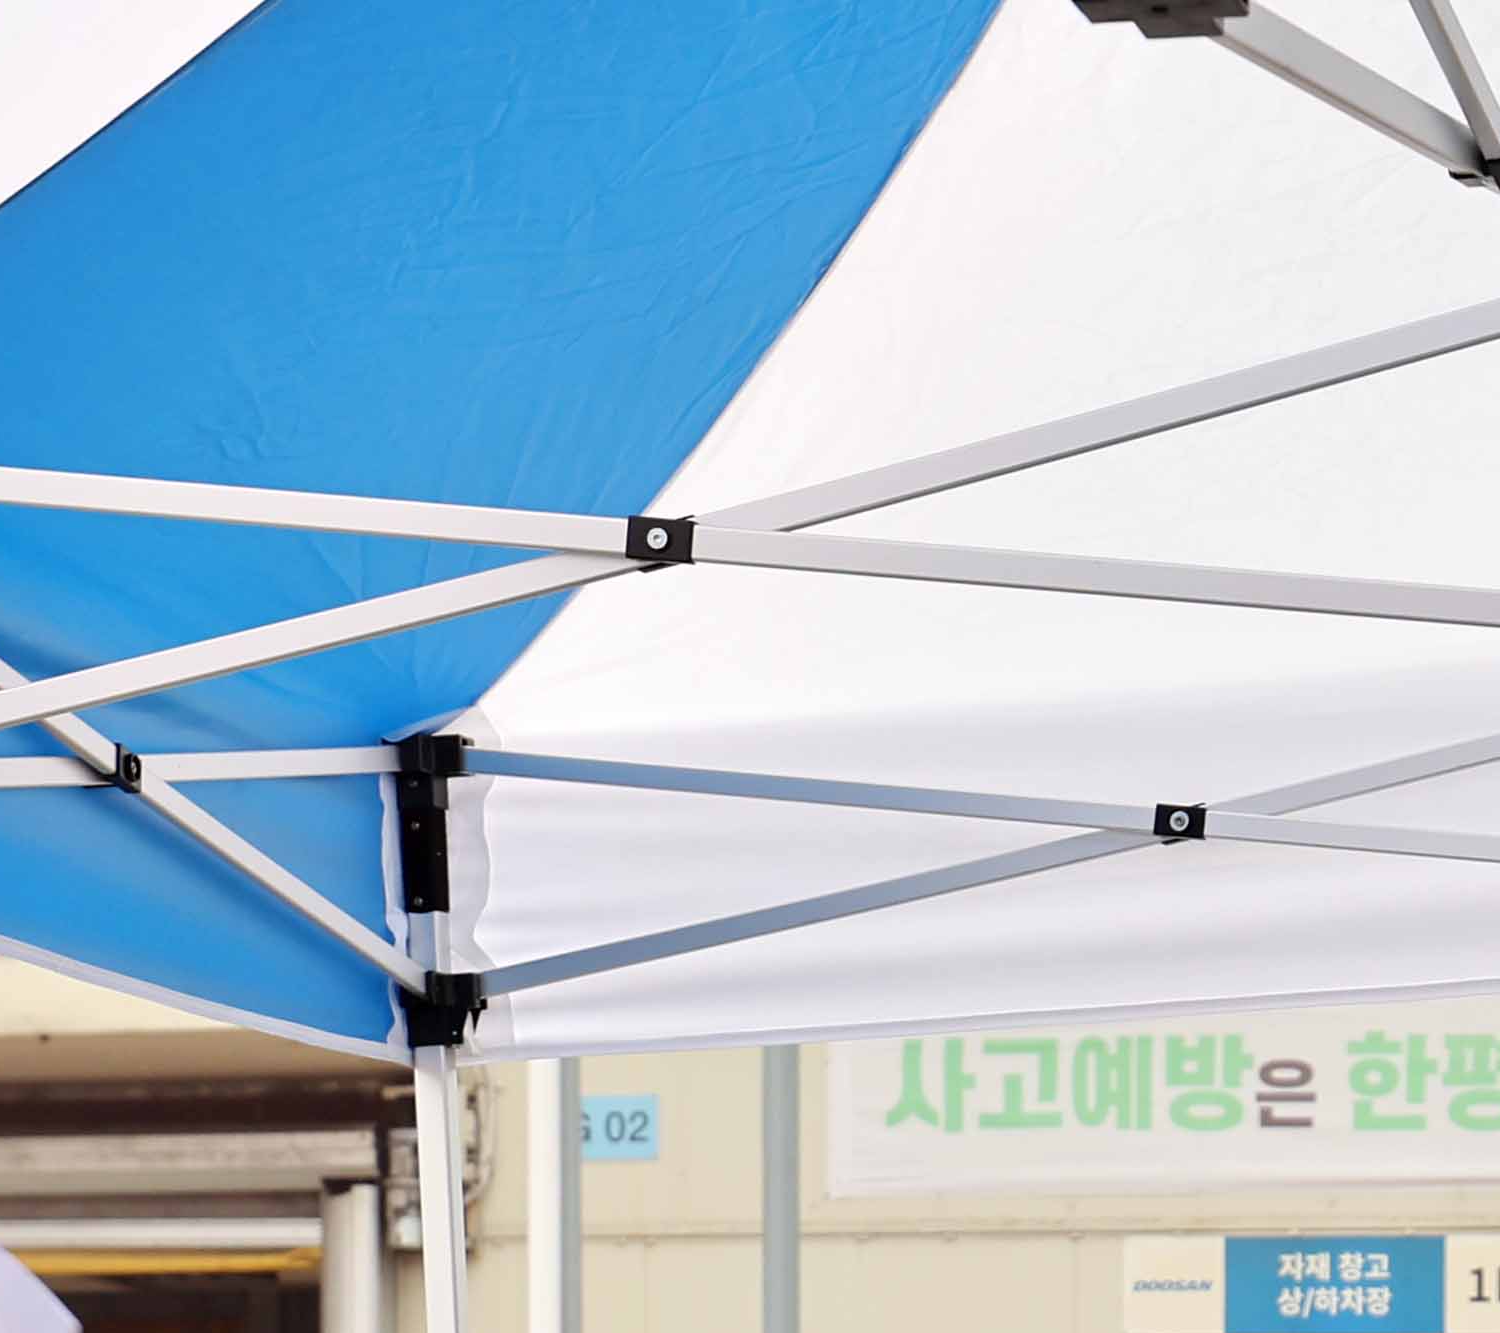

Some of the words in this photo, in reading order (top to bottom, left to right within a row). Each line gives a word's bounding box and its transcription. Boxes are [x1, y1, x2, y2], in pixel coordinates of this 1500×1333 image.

[886, 1033, 1318, 1134] 사고예방은
[604, 1110, 650, 1143] 02
[1277, 1252, 1331, 1282] 자재
[1338, 1252, 1392, 1282] 창고
[1132, 1278, 1214, 1294] DOOSAN
[1276, 1285, 1393, 1318] 상/하차장
